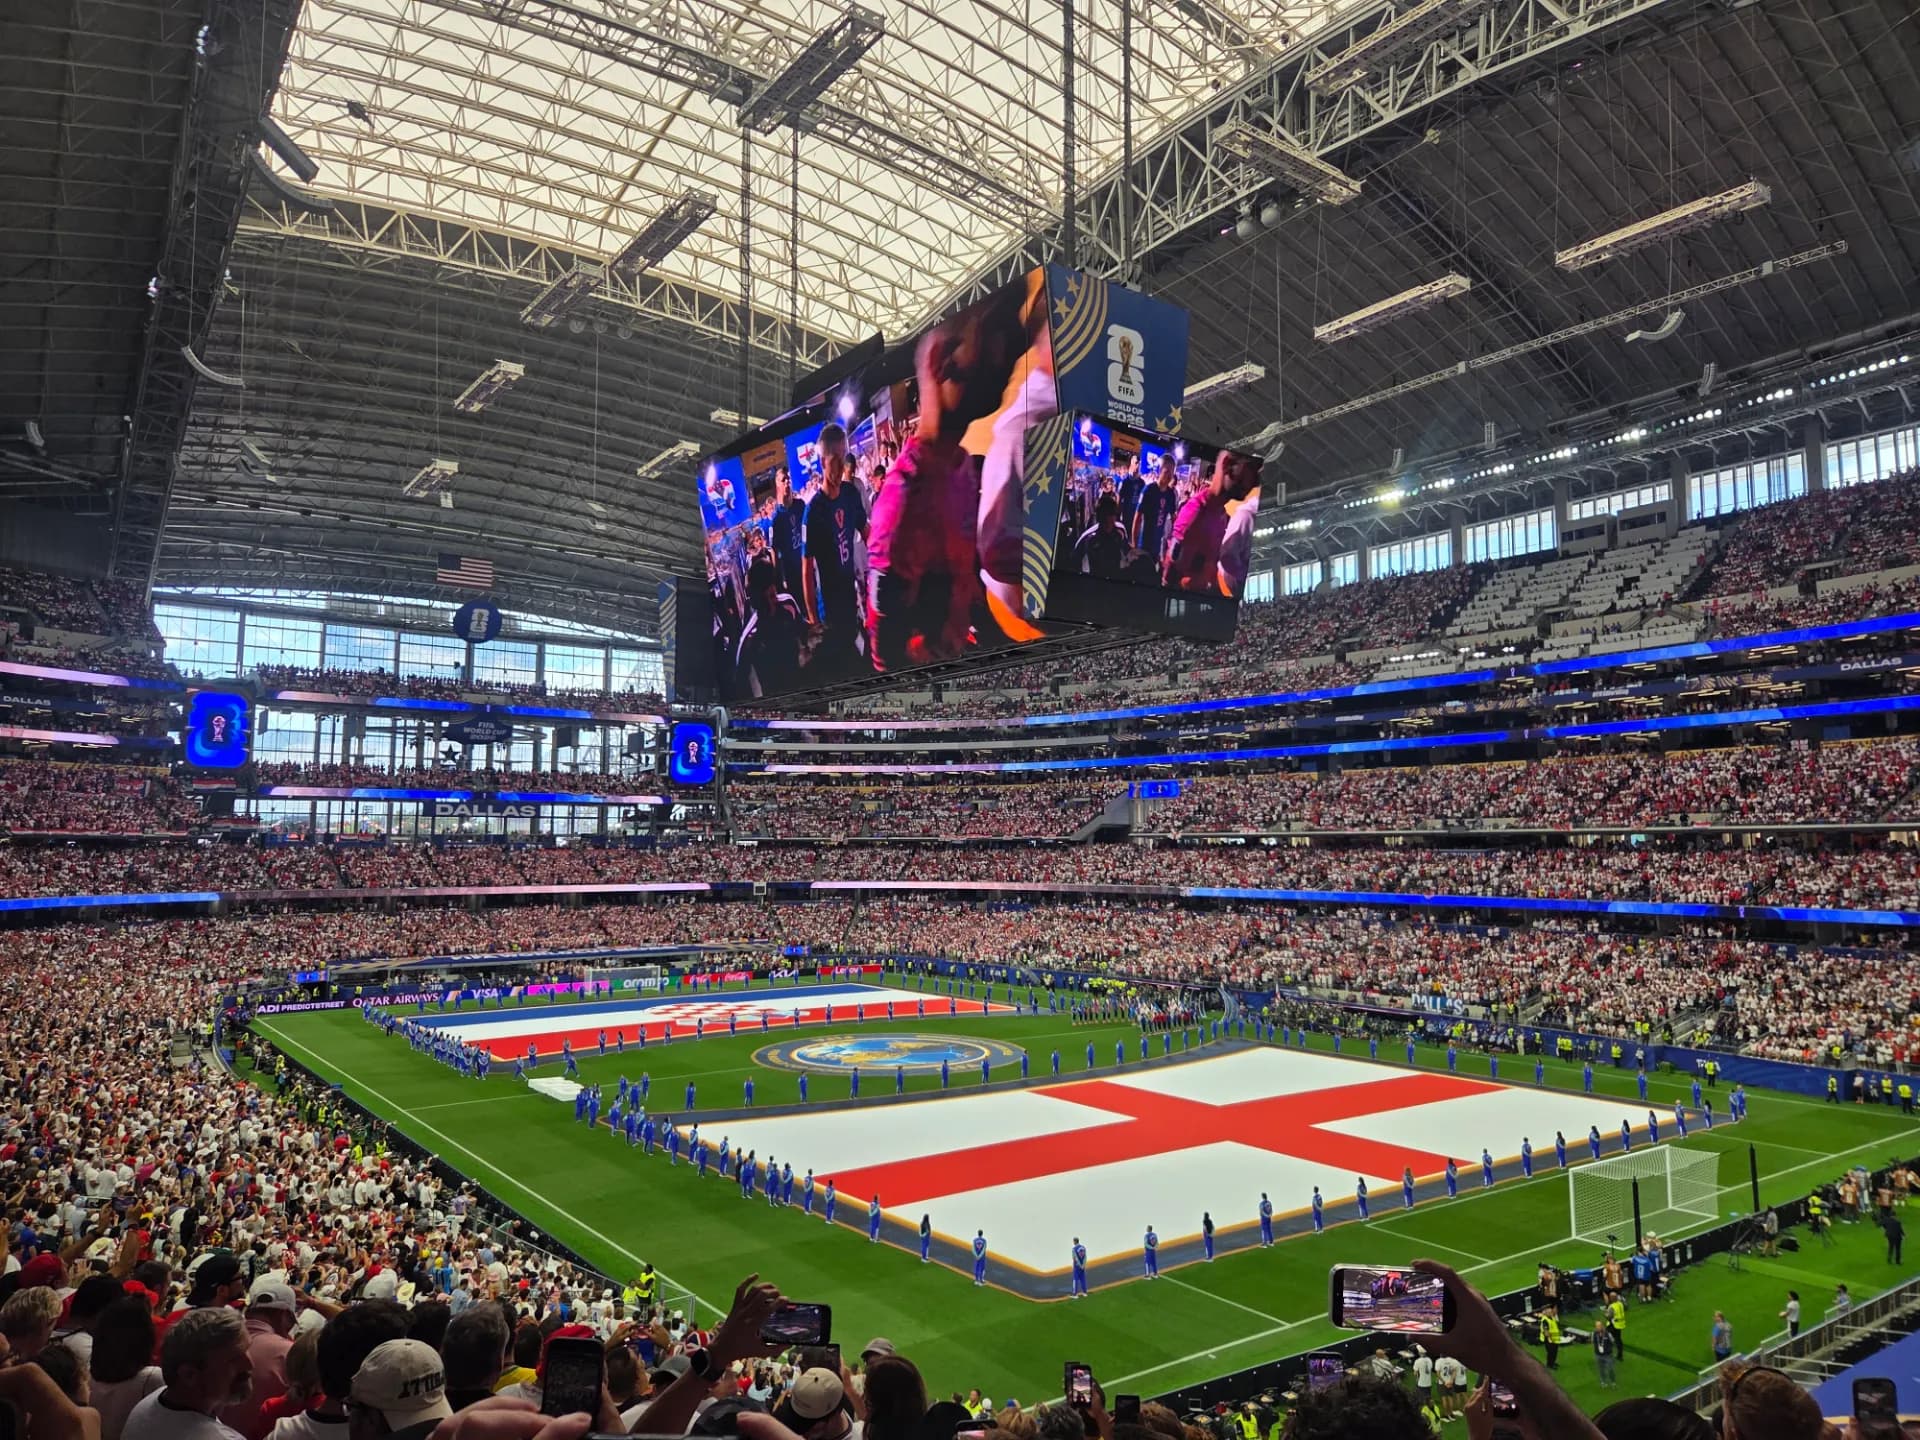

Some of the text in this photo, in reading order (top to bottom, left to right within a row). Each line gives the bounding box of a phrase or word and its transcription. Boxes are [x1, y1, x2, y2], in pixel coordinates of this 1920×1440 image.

[1118, 386, 1135, 397] FIFA
[1108, 400, 1144, 416] WORLD CUP
[1107, 408, 1144, 427] 2026
[839, 540, 849, 566] 15
[1841, 657, 1902, 671] DALLAS
[3, 695, 51, 706] DALLAS
[436, 804, 536, 817] DALLAS
[835, 966, 863, 975] Leov
[623, 976, 669, 988] aramo
[394, 993, 438, 1006] AIRWAYS
[472, 988, 498, 999] VISA
